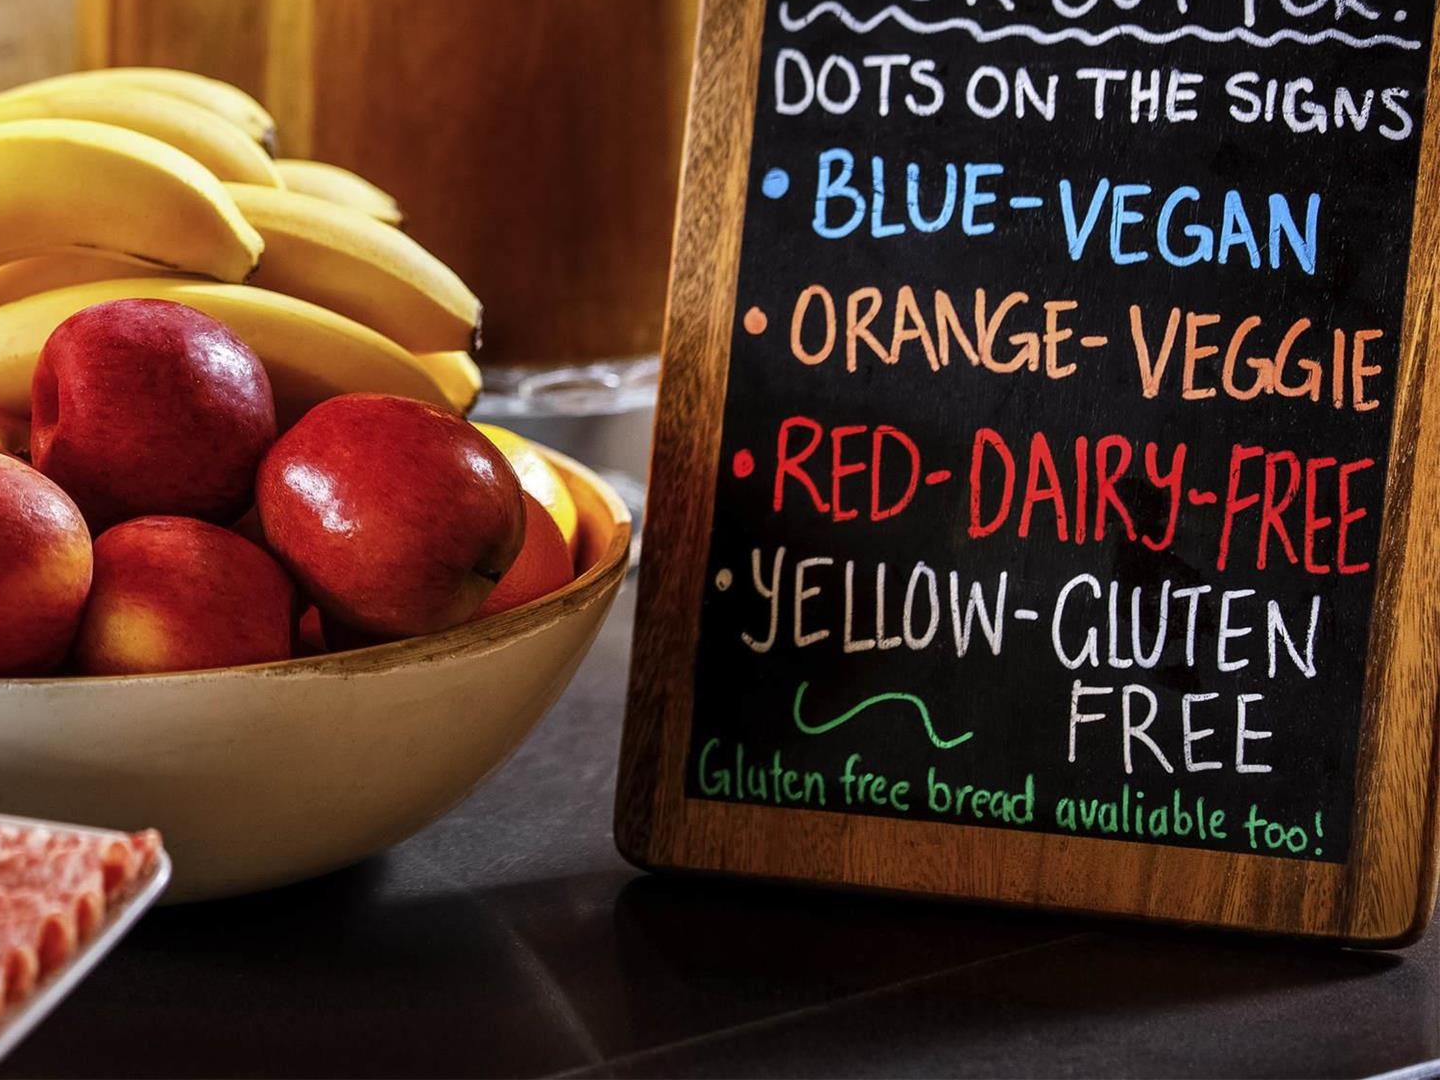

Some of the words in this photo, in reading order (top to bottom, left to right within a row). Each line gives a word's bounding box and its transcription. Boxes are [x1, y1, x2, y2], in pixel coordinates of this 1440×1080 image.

[773, 47, 946, 118] DOTS
[964, 64, 1060, 123] ON
[1074, 66, 1205, 125] THE
[1223, 70, 1415, 142] SIGNS
[1066, 678, 1274, 776] FREE
[698, 737, 827, 808] Gluten
[839, 753, 911, 813] free
[926, 766, 1036, 826] bread
[1054, 782, 1228, 842] avaliable
[1242, 803, 1327, 857] too!
